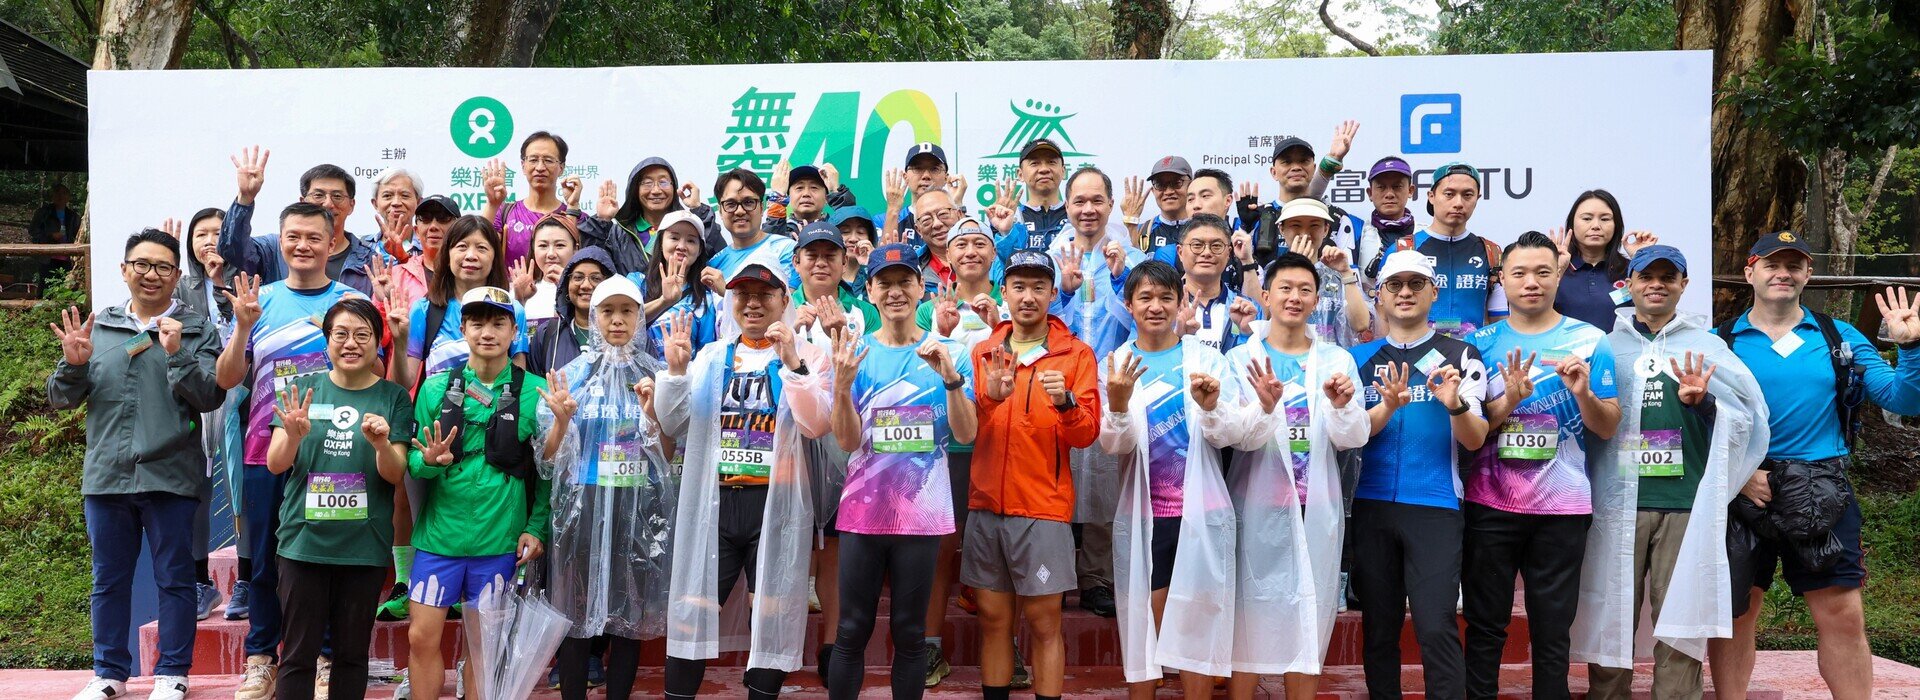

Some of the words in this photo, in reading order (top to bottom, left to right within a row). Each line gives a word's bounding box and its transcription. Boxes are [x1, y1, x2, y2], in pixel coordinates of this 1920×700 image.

[381, 147, 407, 160] 主辦
[1203, 154, 1251, 167] Principal
[1253, 154, 1274, 166] Spo
[1328, 170, 1367, 203] 富
[1411, 167, 1533, 201] FTU
[1456, 274, 1488, 290] 證券
[884, 427, 922, 441] L001
[1506, 434, 1546, 448] L030
[324, 439, 353, 449] OXFAM
[324, 449, 337, 457] Hong
[721, 450, 763, 463] 0555B
[318, 494, 358, 508] L006
